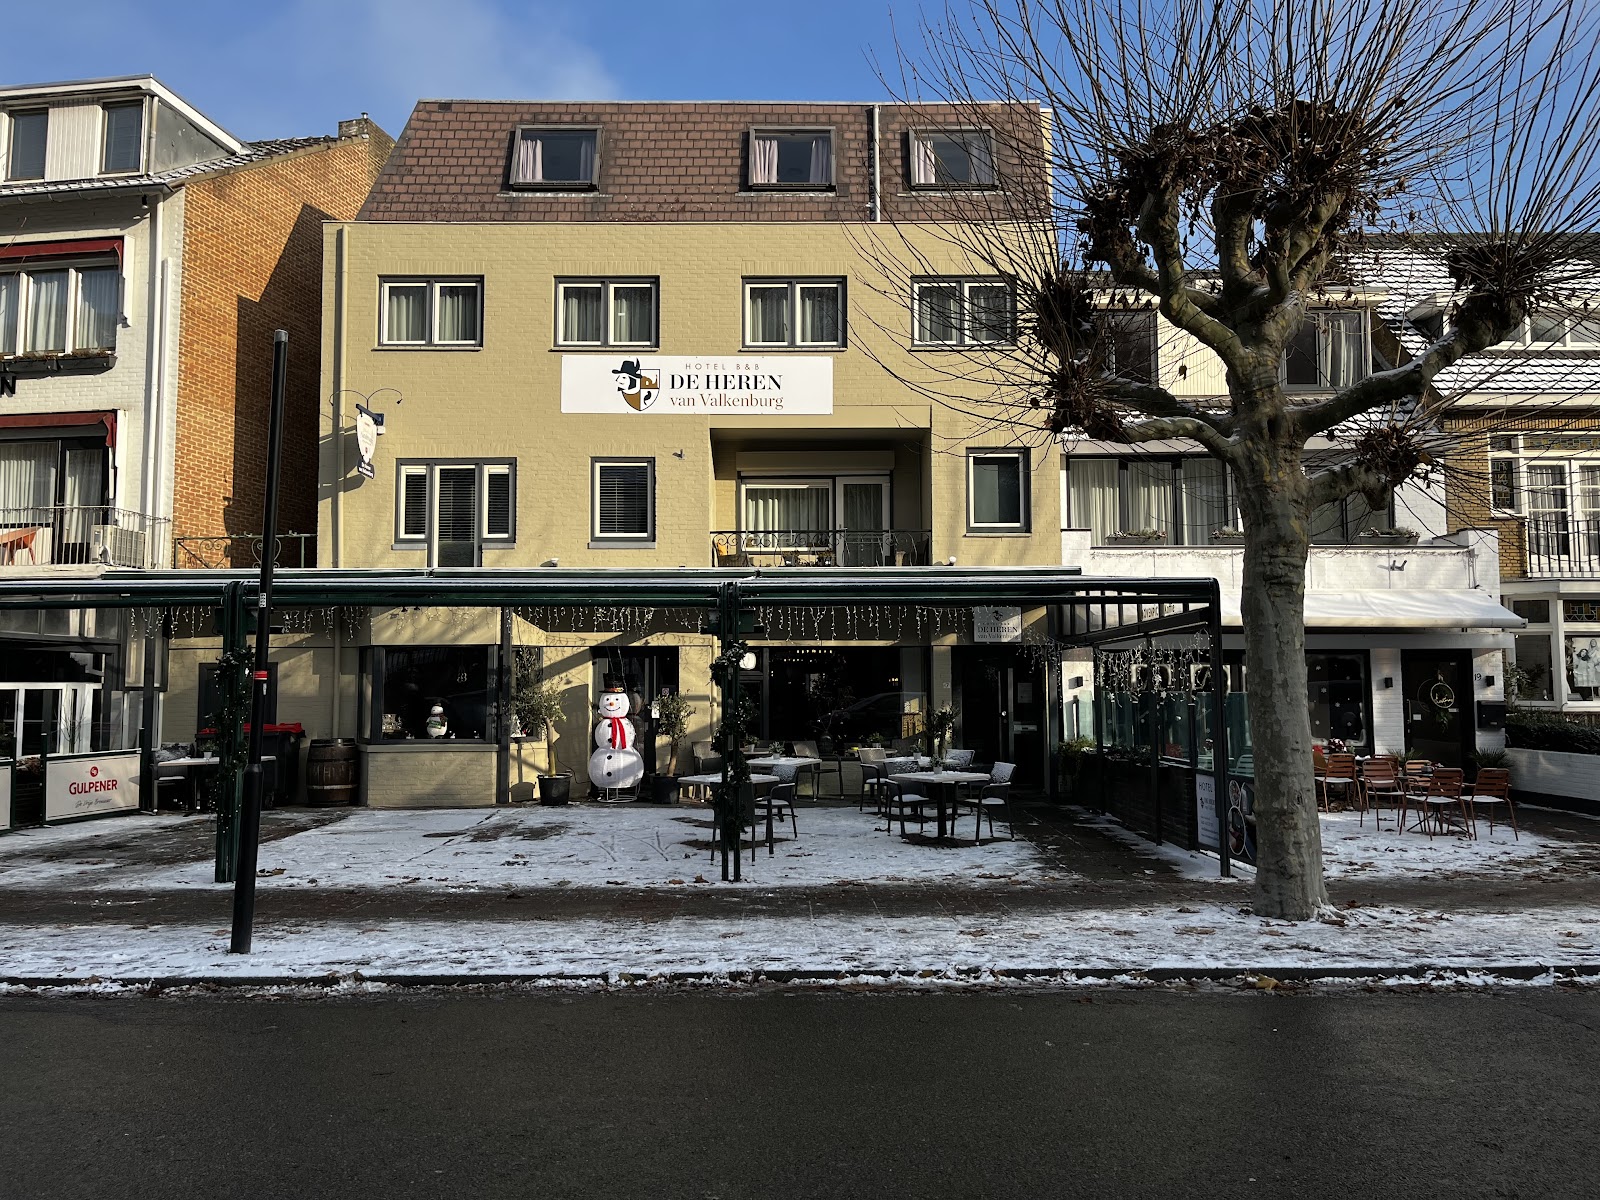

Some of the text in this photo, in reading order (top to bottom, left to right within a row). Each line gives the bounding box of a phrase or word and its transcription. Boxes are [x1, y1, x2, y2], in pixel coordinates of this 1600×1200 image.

[685, 363, 760, 371] HOTEL B&B
[670, 374, 783, 390] DE HEREN
[670, 393, 784, 410] van Valkenburg
[1474, 672, 1482, 680] 19
[69, 779, 118, 795] GULPENER
